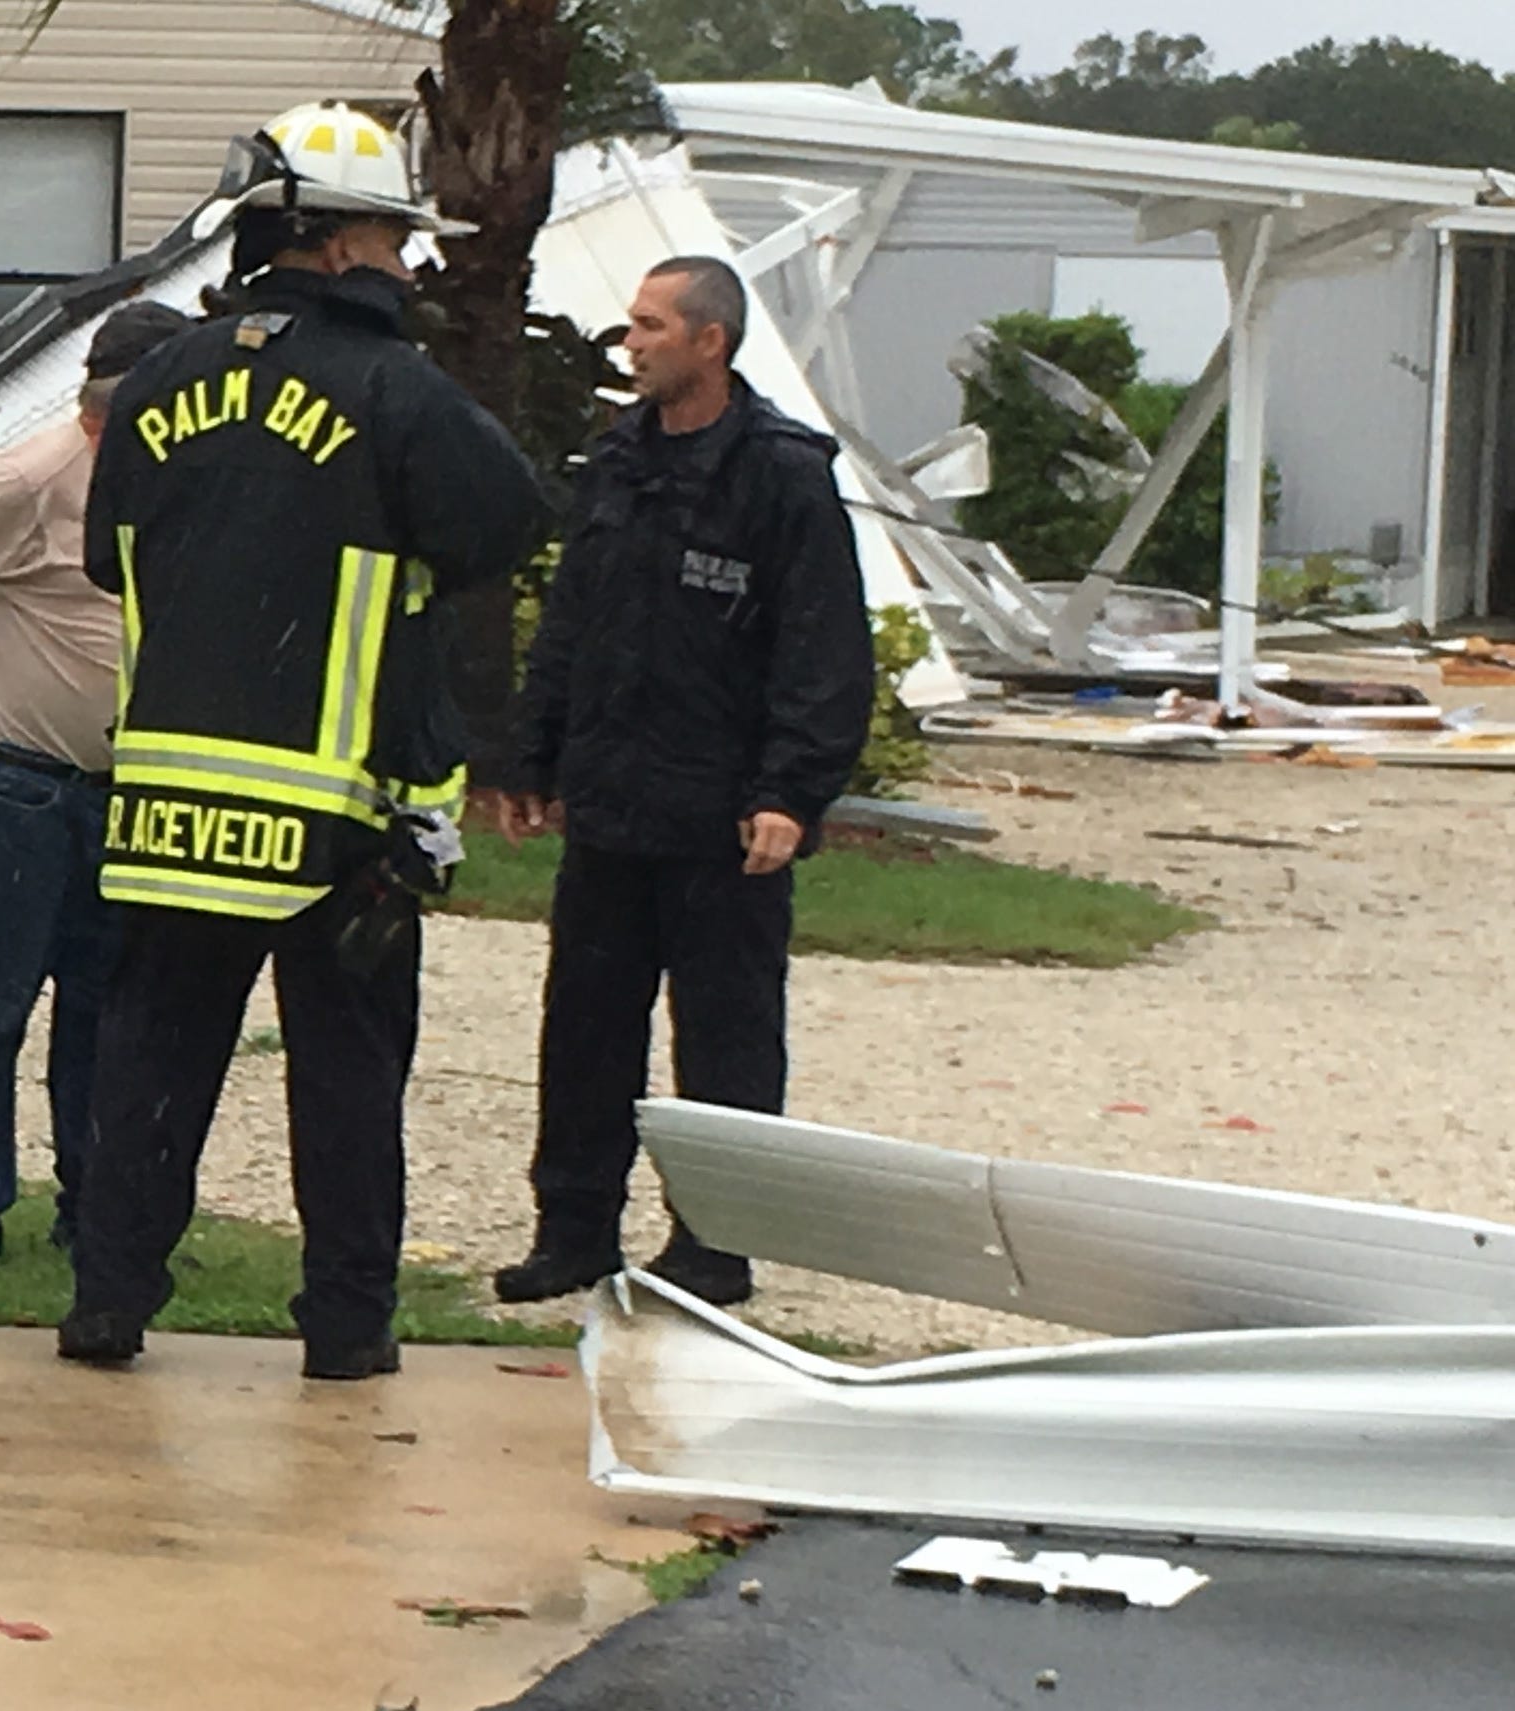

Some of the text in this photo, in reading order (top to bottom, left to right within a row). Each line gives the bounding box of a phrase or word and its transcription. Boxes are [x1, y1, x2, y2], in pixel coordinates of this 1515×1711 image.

[137, 368, 357, 465] PALM BAY
[130, 798, 305, 872] ACEVEDO
